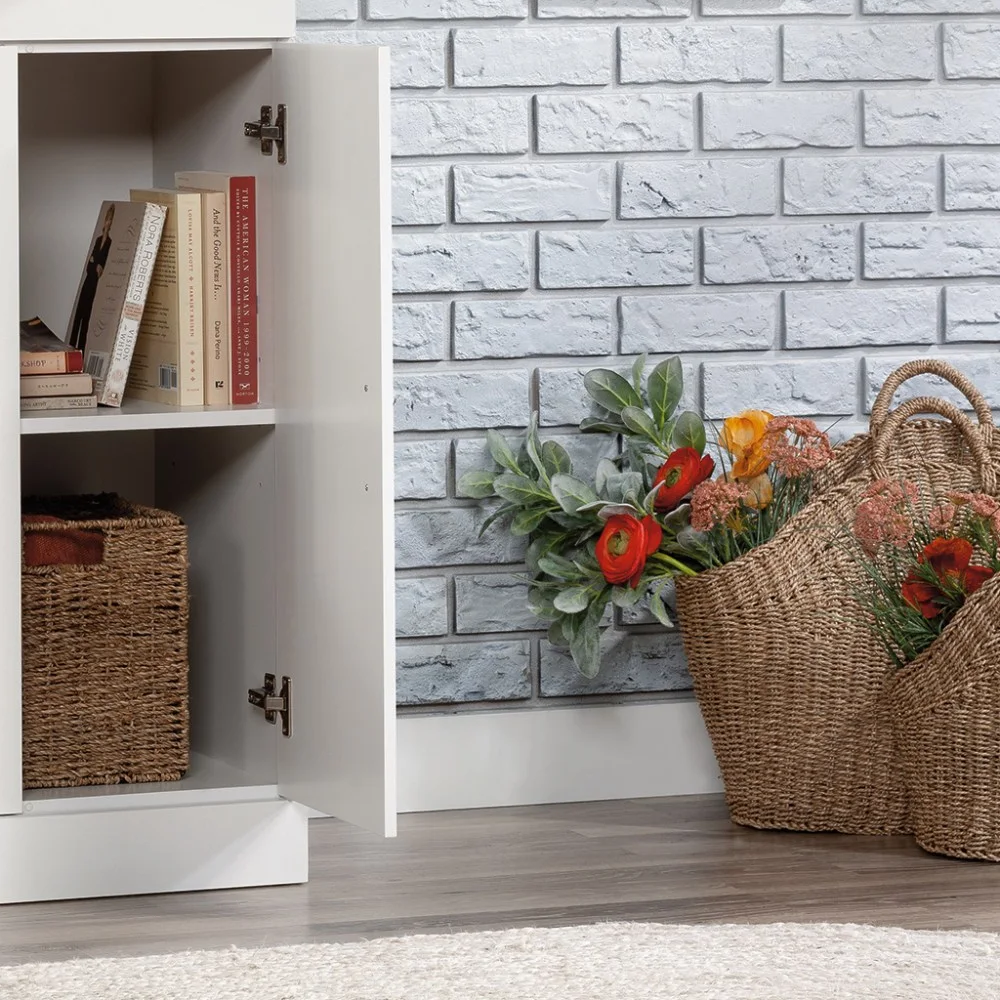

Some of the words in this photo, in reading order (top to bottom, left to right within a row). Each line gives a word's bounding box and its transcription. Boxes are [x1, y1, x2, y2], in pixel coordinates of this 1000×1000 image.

[144, 215, 160, 246] NORA
[213, 226, 221, 238] the
[213, 239, 221, 261] Good
[132, 250, 152, 301] ROBERTS
[115, 333, 127, 361] WHITE
[123, 329, 134, 361] VISION
